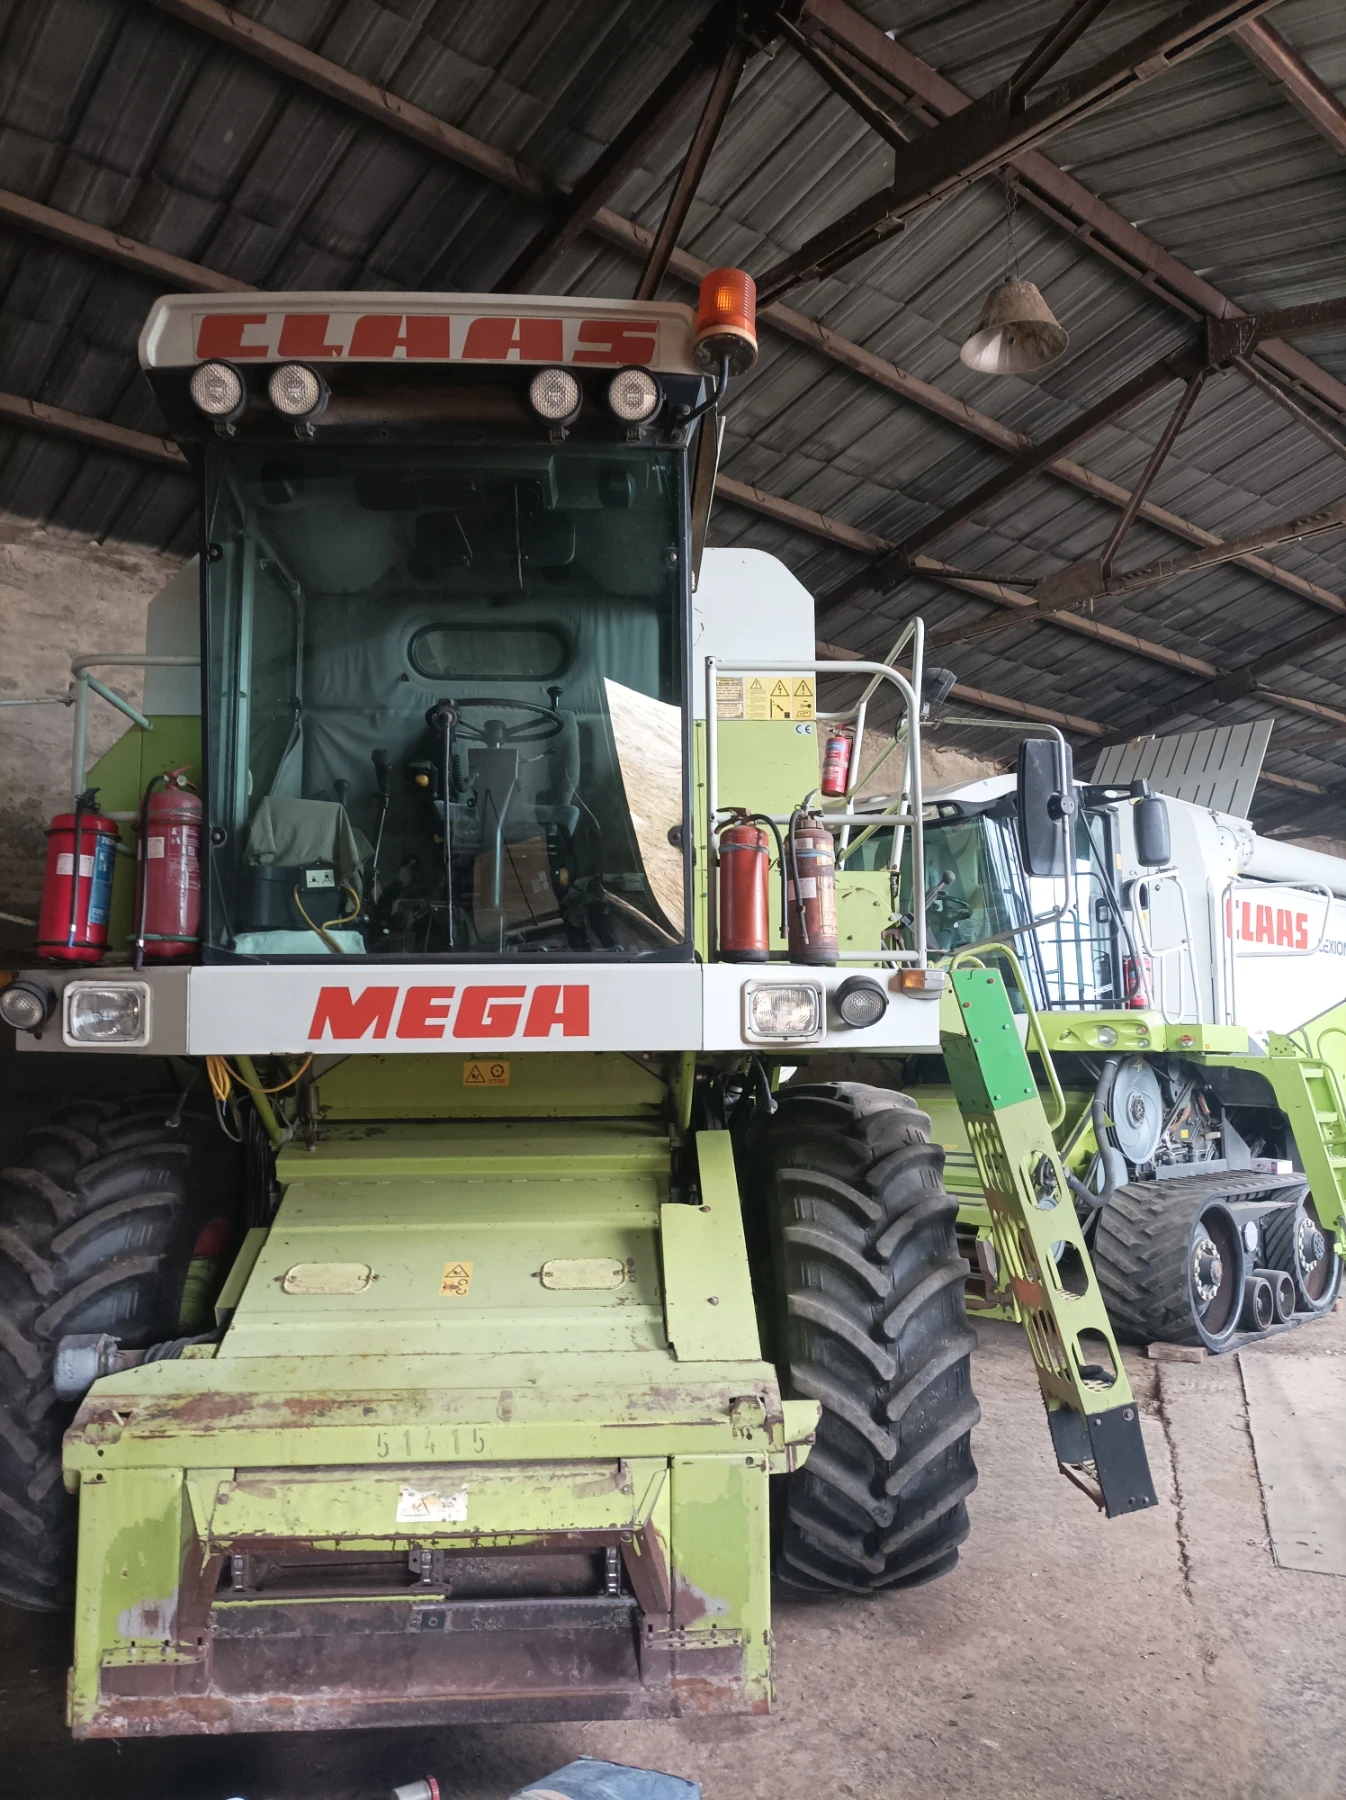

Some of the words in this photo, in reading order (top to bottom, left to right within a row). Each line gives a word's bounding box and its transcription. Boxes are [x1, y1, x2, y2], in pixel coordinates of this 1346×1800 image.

[196, 313, 659, 364] CLAAS
[795, 724, 811, 734] CE
[1318, 938, 1346, 956] LEXIO
[307, 985, 590, 1039] MEGA
[377, 1428, 485, 1458] 51415
